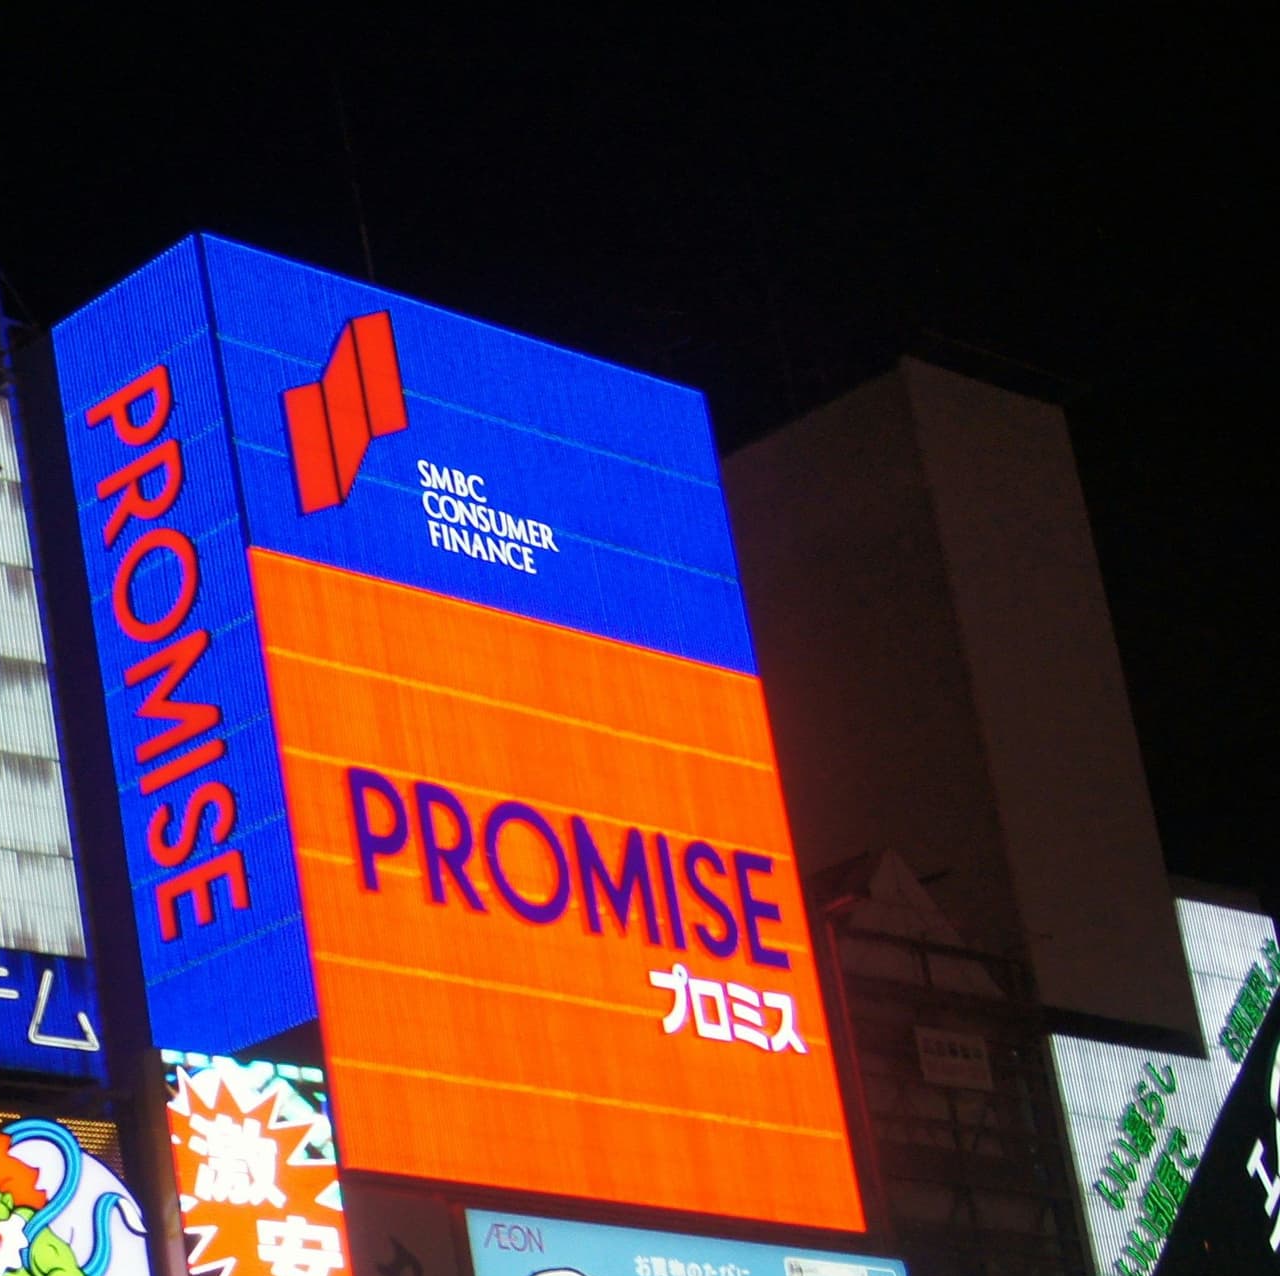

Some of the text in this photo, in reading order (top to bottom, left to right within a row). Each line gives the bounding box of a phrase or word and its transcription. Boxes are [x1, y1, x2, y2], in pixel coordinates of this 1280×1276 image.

[416, 460, 488, 503] SMBC
[421, 490, 559, 553] CONSUMER
[427, 520, 537, 575] FINANCE
[87, 365, 249, 942] PROMISE
[347, 766, 791, 970] PROMISE
[648, 962, 809, 1054] プロミス
